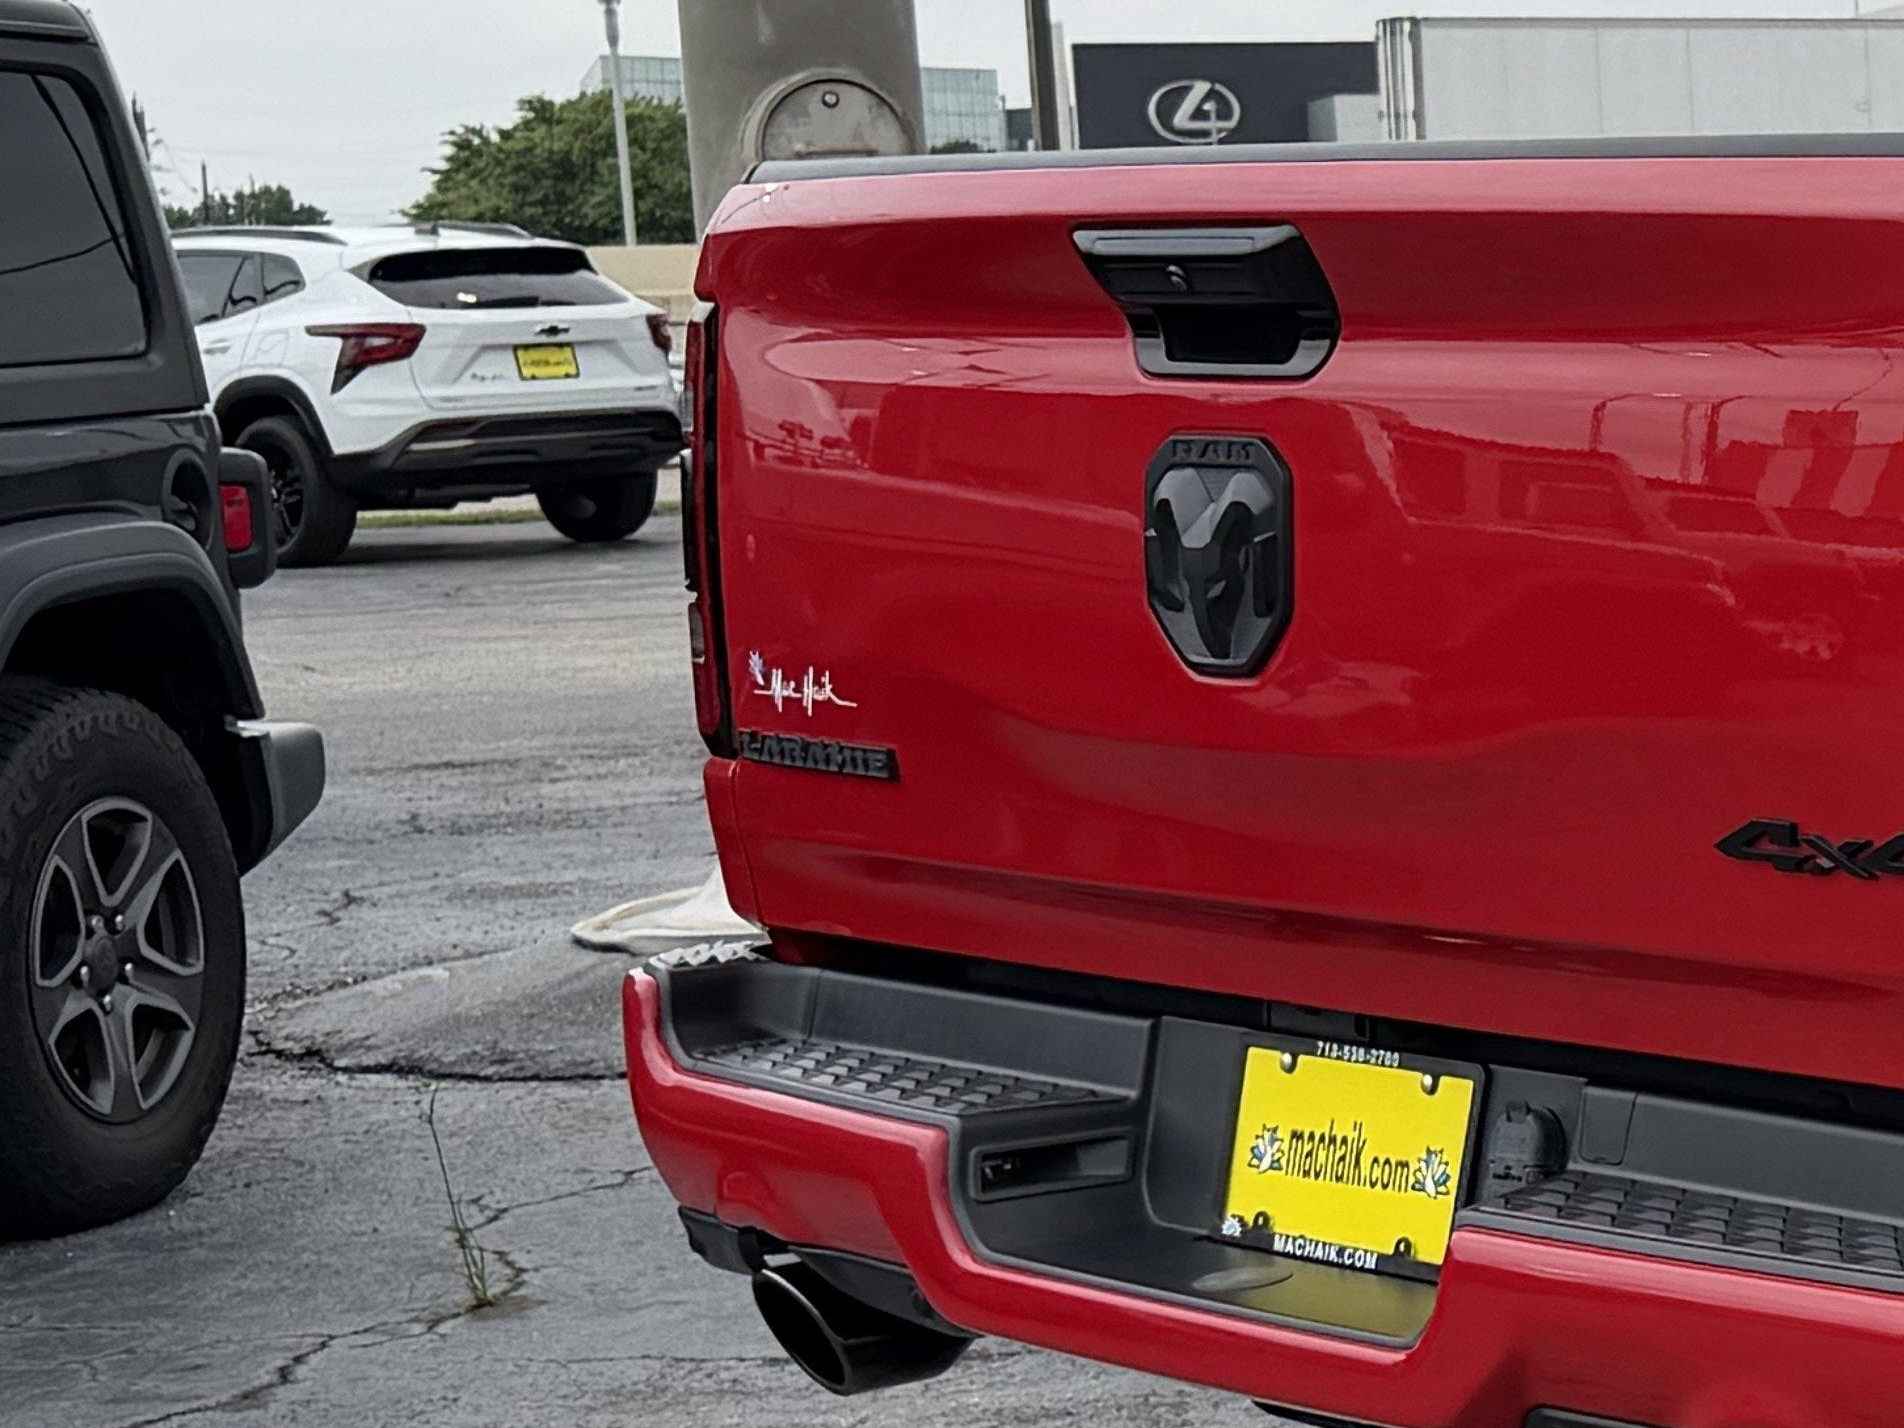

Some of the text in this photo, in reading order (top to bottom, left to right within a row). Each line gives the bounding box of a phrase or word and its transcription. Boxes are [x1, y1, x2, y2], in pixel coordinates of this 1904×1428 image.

[1172, 439, 1257, 461] RAM
[740, 732, 892, 779] LARAMIE
[1284, 1118, 1411, 1194] machaik.com
[1273, 1234, 1379, 1270] MACHAIK.COM
